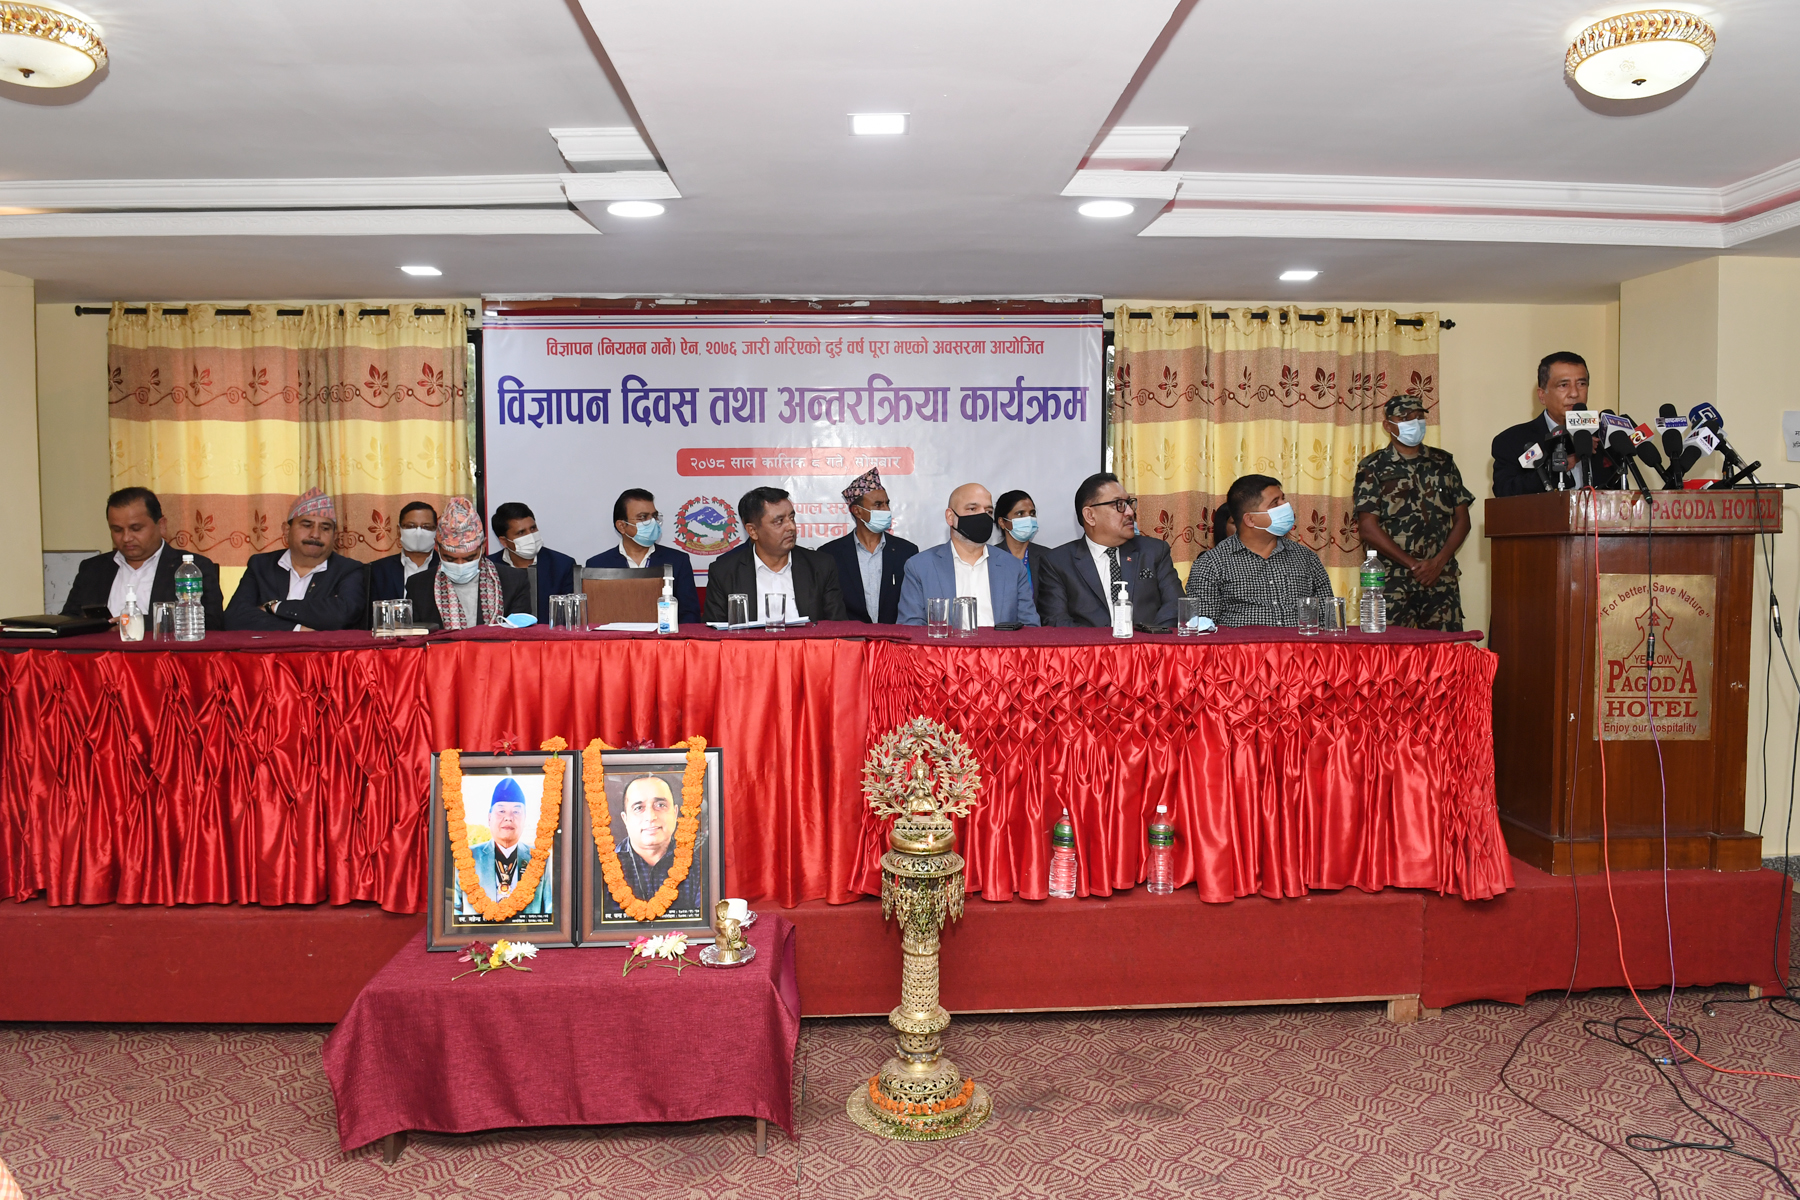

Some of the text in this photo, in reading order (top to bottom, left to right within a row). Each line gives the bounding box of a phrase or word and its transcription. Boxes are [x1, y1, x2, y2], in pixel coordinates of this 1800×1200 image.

[546, 337, 593, 357] विज्ञापन
[597, 337, 647, 356] (नियमन
[651, 337, 676, 356] गर्ने)
[705, 341, 737, 356] २०७६
[742, 336, 770, 355] जारी
[774, 336, 821, 355] गरिएको
[825, 337, 843, 359] दुई
[847, 337, 865, 354] वर्ष
[869, 340, 890, 359] पूरा
[894, 336, 929, 355] भएको
[933, 340, 986, 355] अवसरमा
[990, 335, 1045, 355] आयोजित
[497, 373, 1089, 429] विज्ञापन दिवस तथा अन्तरक्रिया कार्यक्रम
[690, 457, 725, 470] २०७८
[731, 457, 757, 469] साल
[793, 502, 823, 515] पाल
[1651, 499, 1717, 520] PAGODA
[1722, 499, 1777, 520] HOTEL
[1617, 584, 1650, 603] better,
[1652, 582, 1676, 595] Save
[1634, 654, 1673, 665] YEOW
[1606, 701, 1698, 717] HOTEL
[1604, 722, 1629, 734] Enjoy
